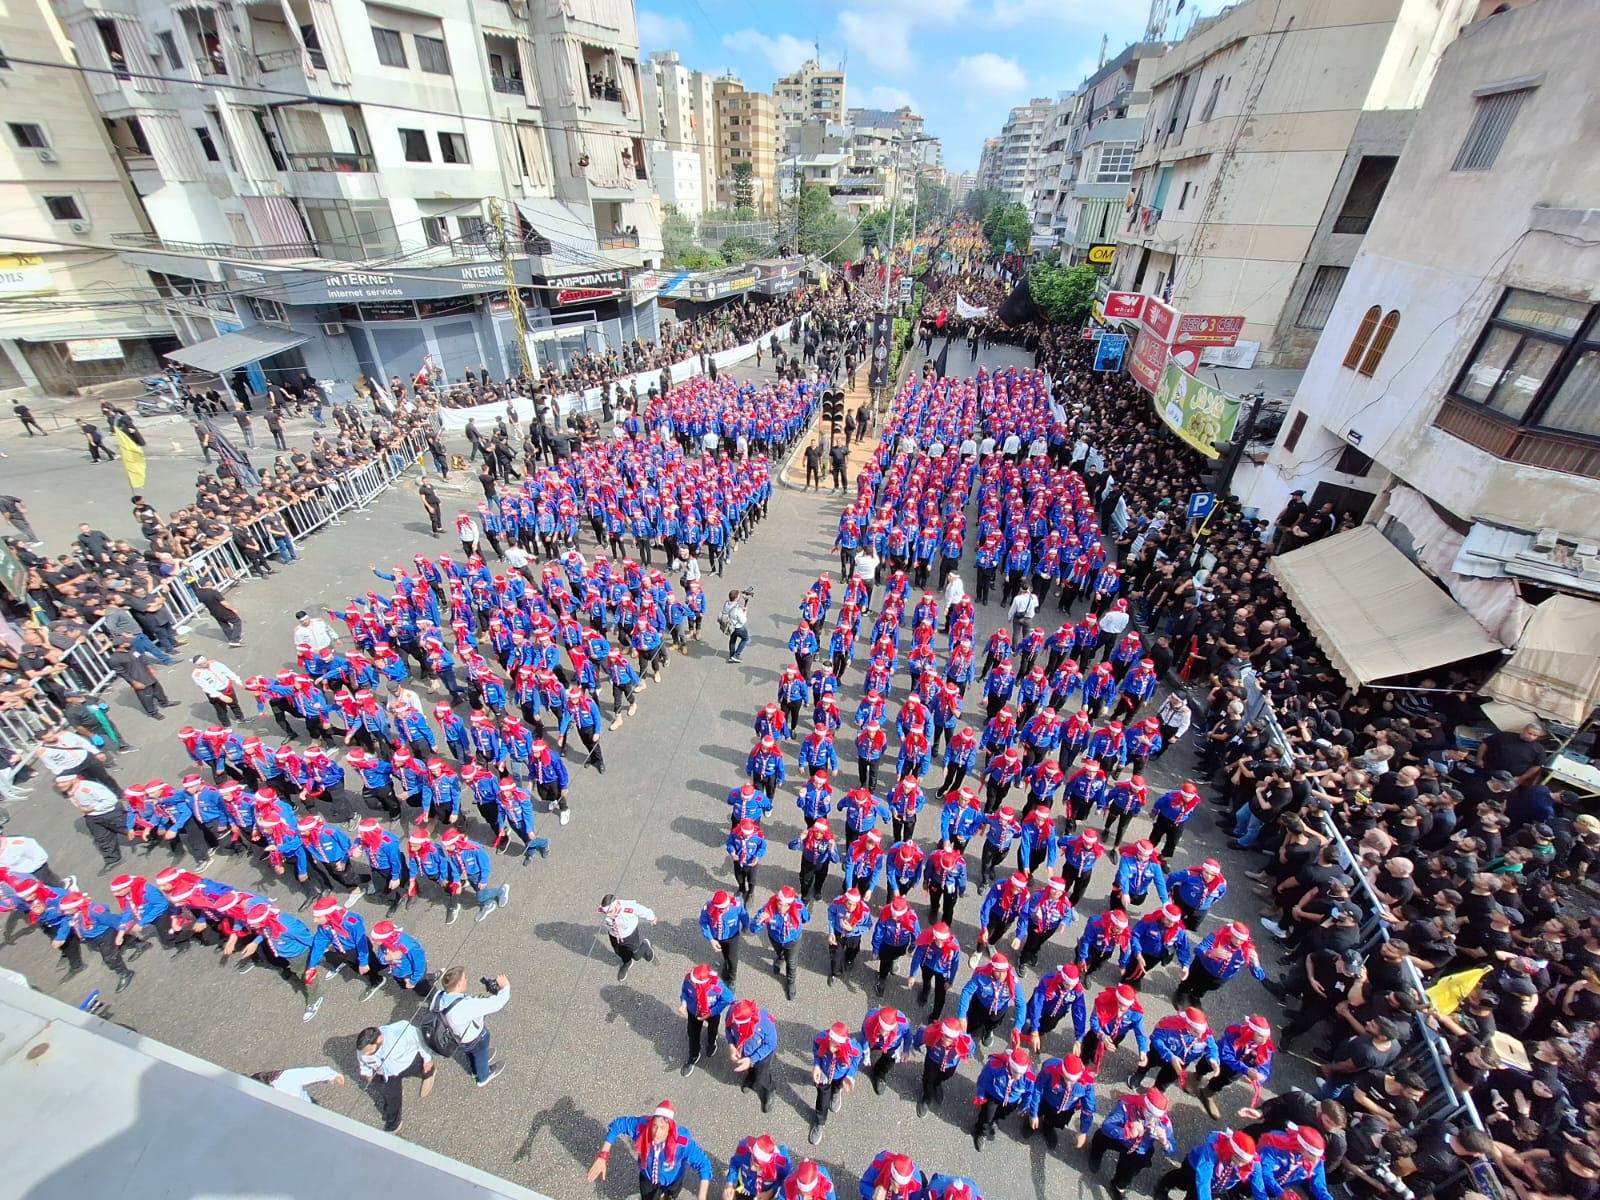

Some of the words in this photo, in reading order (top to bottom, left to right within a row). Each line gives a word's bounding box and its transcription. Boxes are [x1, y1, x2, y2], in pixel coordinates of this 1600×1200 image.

[1094, 250, 1113, 259] OM
[326, 272, 394, 287] INTERNET
[461, 265, 504, 280] INTERNE
[547, 272, 617, 288] CAMPOMATIC
[328, 289, 363, 298] internet
[366, 288, 403, 297] services
[1208, 318, 1217, 332] 3
[1217, 317, 1241, 332] CELL
[1190, 386, 1225, 419] فلافل
[1193, 495, 1209, 512] P
